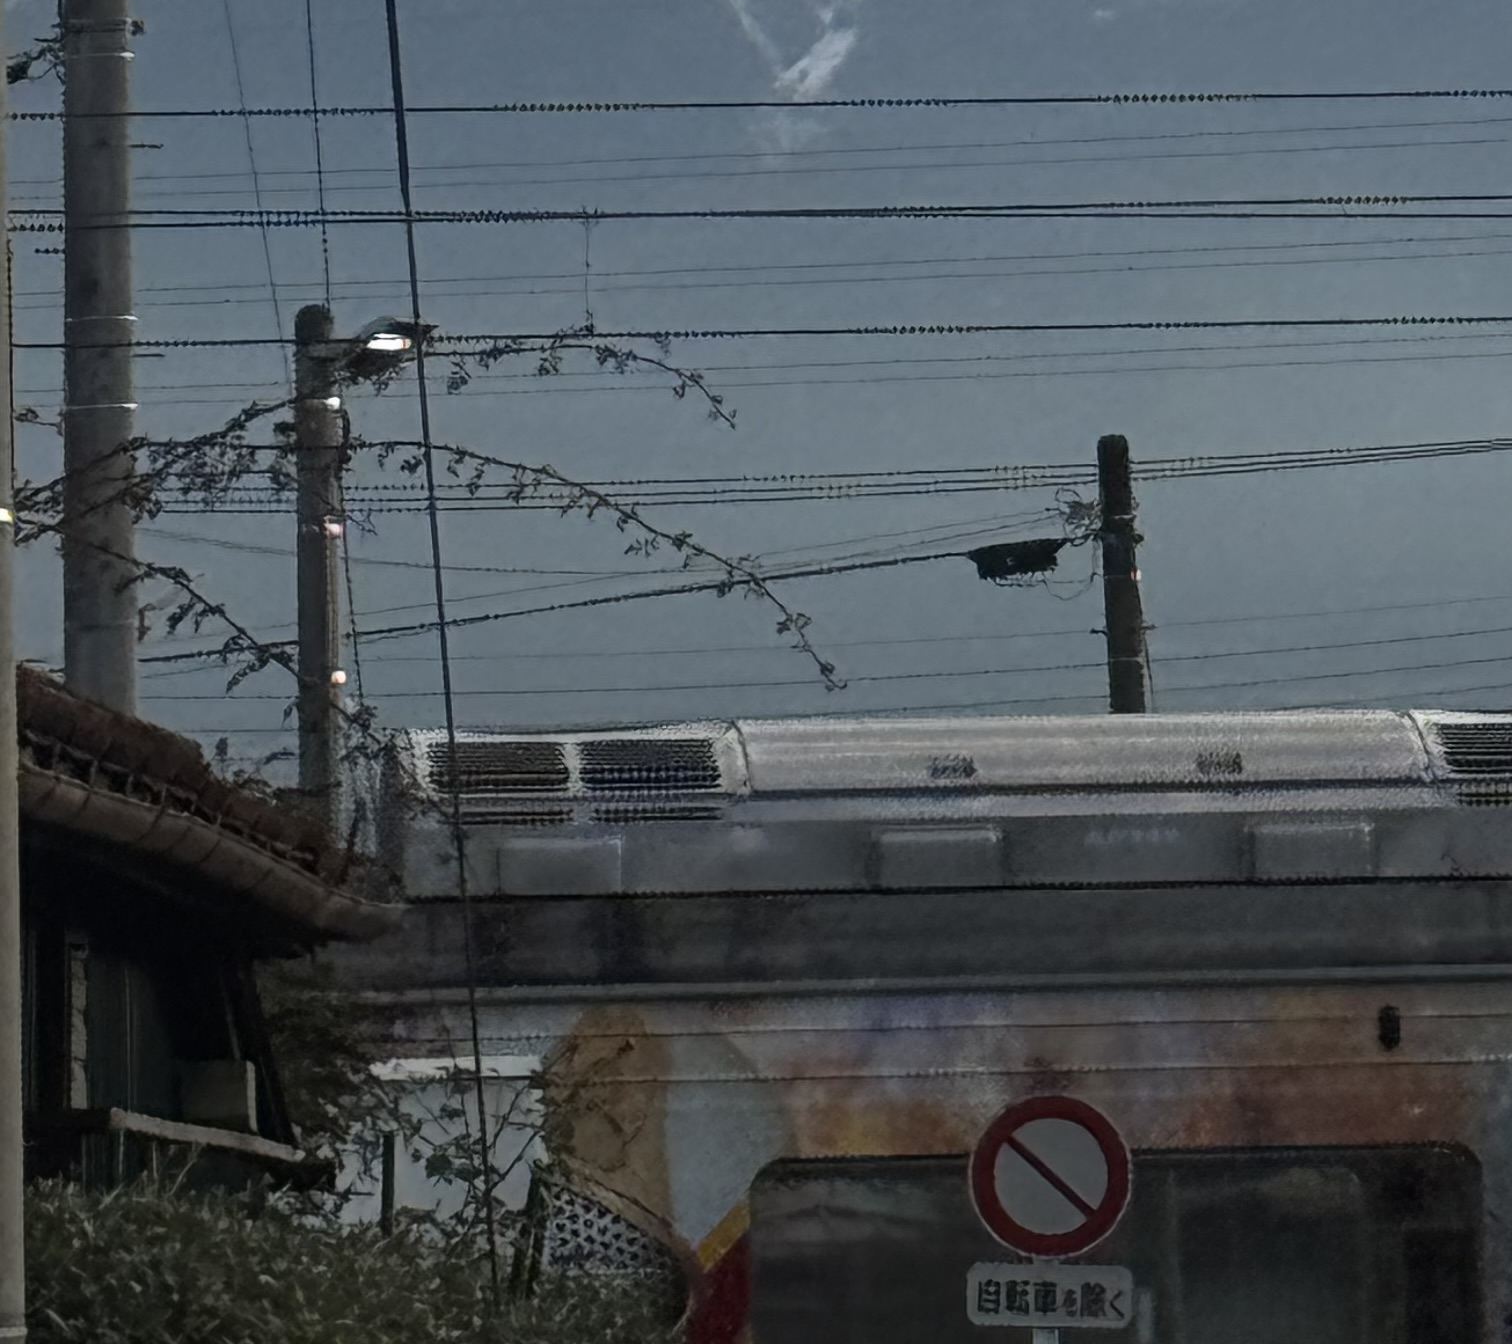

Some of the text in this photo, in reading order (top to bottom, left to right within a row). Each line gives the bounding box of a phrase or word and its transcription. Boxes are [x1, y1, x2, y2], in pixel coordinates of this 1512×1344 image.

[977, 1277, 1125, 1319] 自転車を除く
